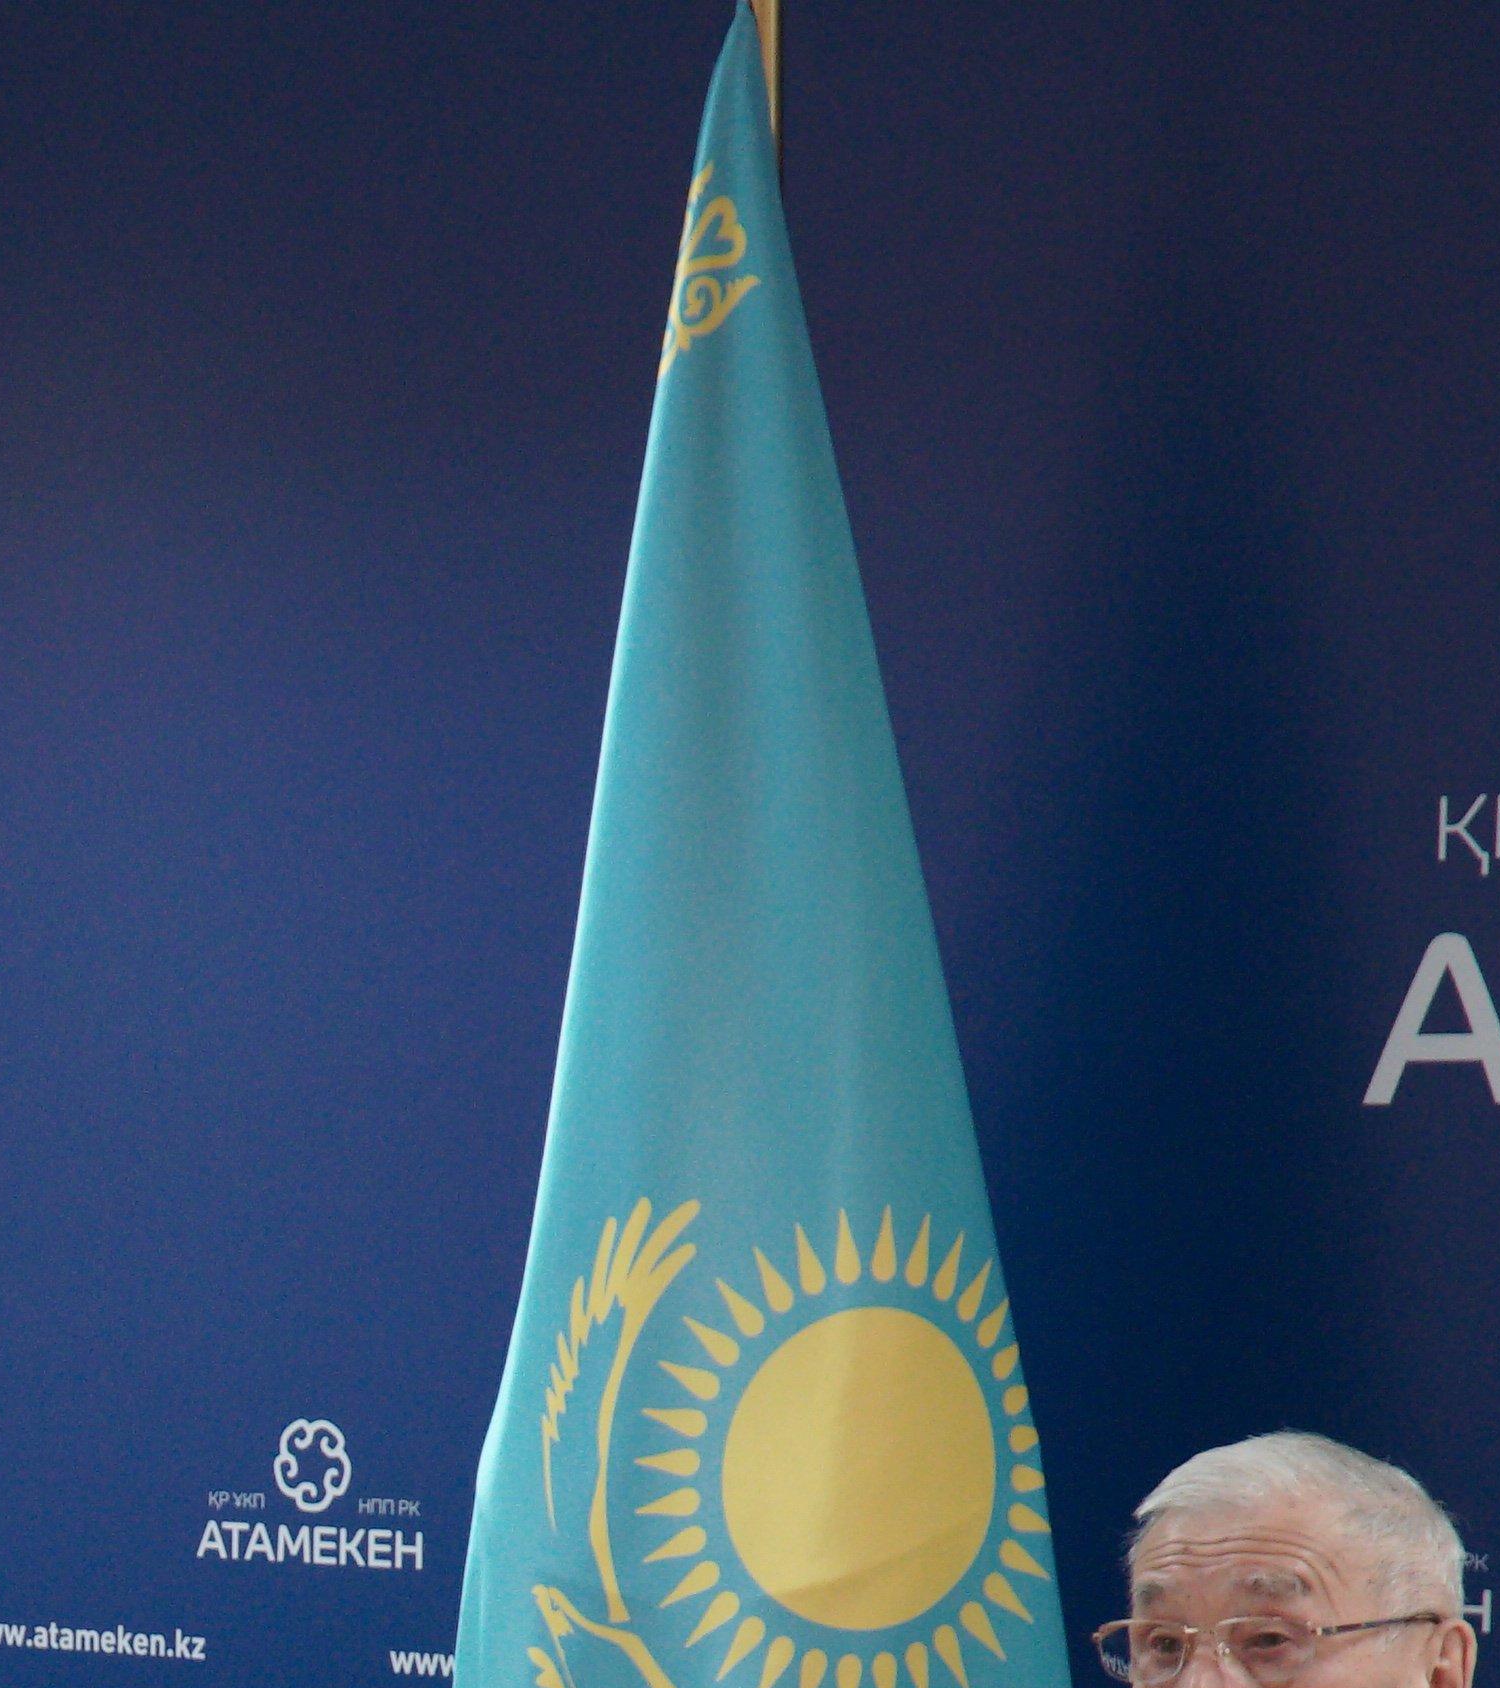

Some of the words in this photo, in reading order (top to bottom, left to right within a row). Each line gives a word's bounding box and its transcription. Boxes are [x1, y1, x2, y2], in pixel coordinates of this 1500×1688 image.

[357, 1497, 396, 1515] НПП
[397, 1498, 421, 1517] РК
[196, 1519, 424, 1571] АТАМЕКЕН
